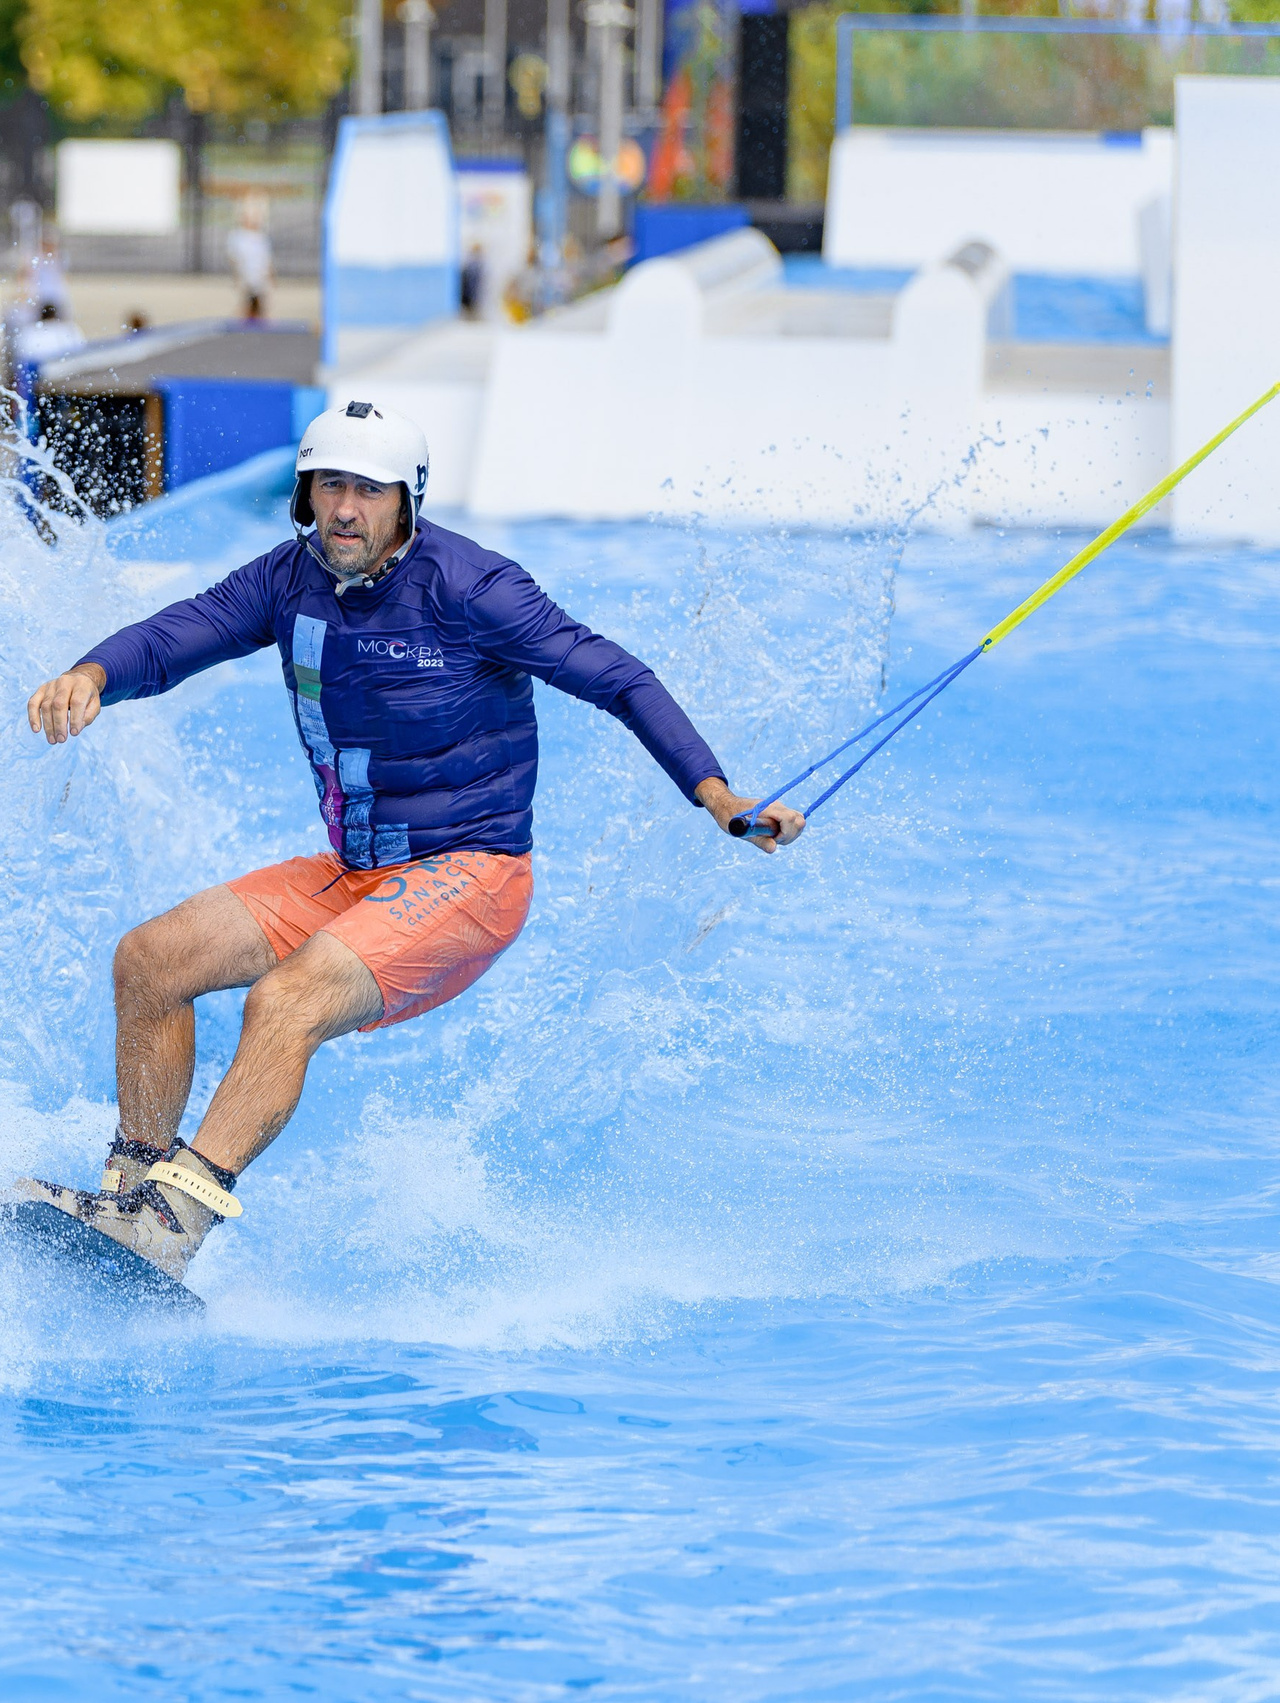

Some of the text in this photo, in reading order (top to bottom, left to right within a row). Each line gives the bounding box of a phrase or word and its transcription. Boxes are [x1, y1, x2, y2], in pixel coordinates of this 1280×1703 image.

[357, 639, 444, 659] МОСКВА
[417, 659, 444, 667] 2023
[389, 879, 448, 920] SANA
